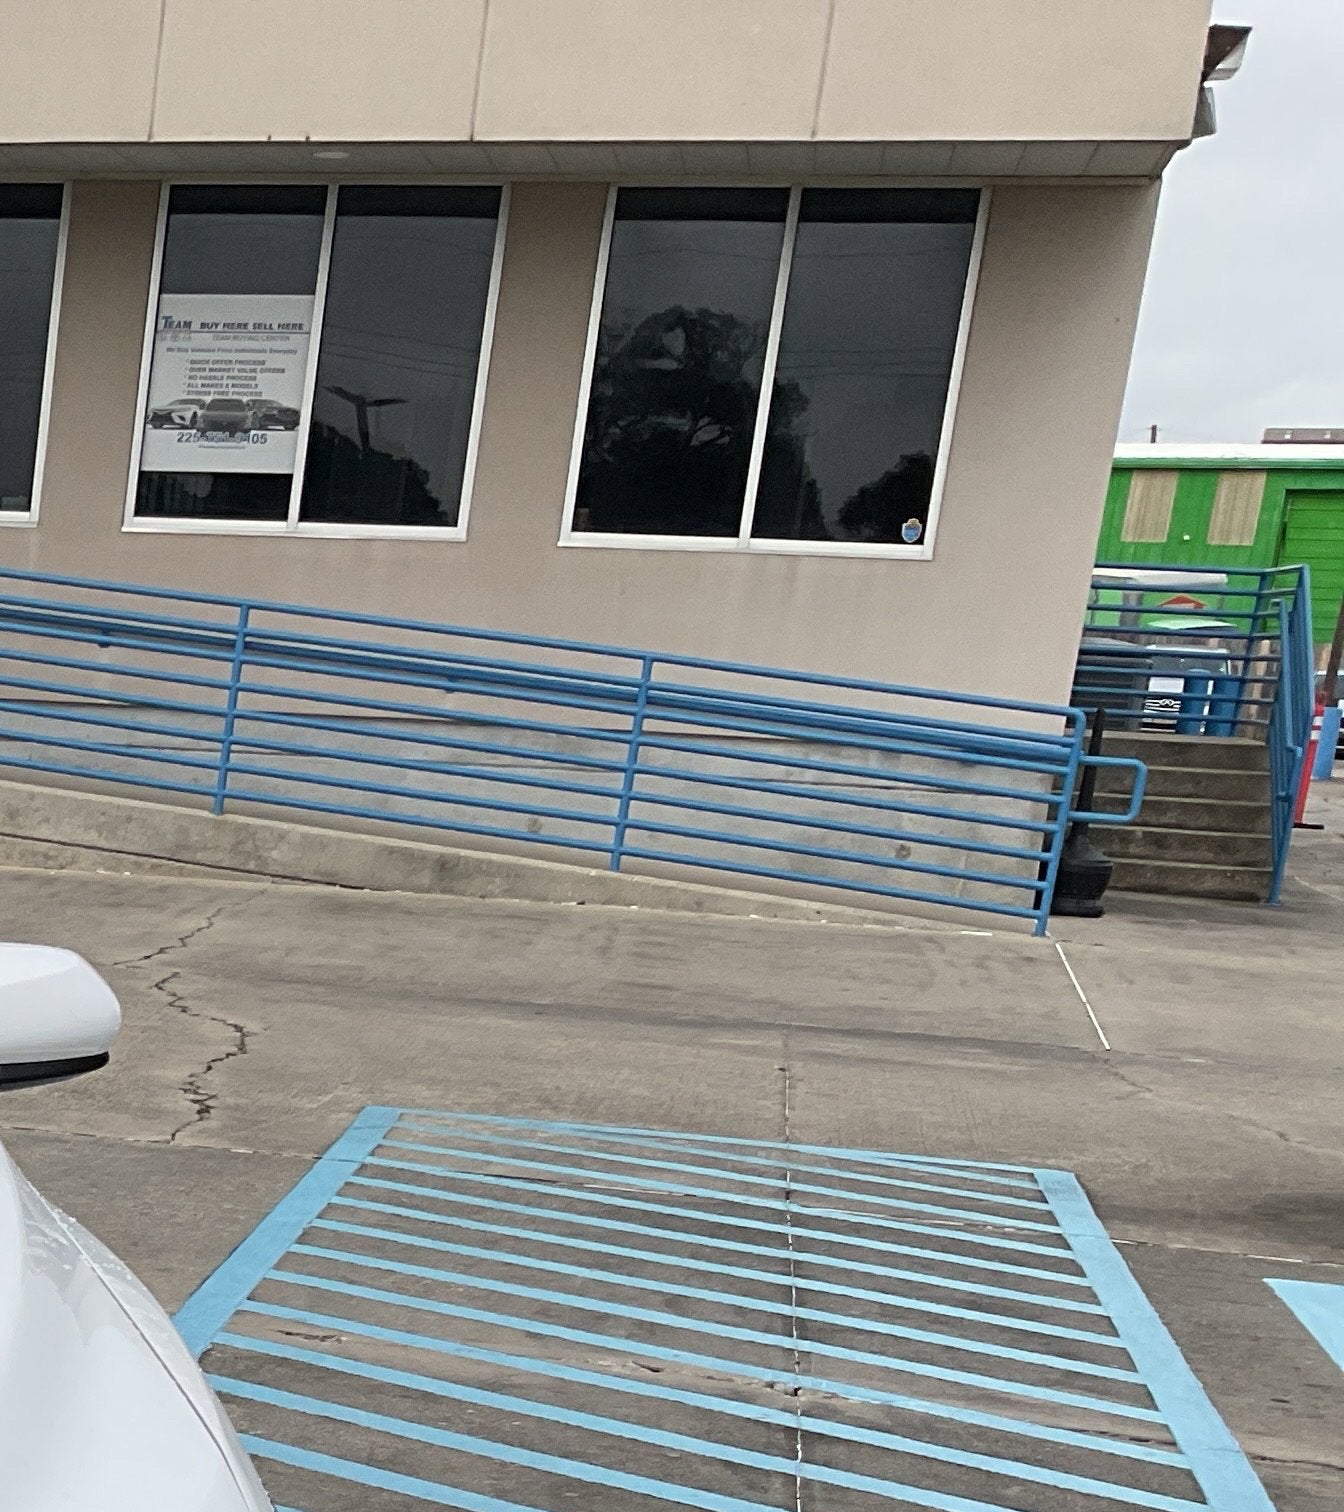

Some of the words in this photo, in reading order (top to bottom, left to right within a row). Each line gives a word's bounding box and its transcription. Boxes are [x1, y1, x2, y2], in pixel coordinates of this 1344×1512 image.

[161, 315, 192, 330] TEAM
[200, 322, 220, 330] BUY
[222, 322, 249, 330] HERE
[252, 322, 274, 331] SELL
[277, 322, 305, 331] HERE
